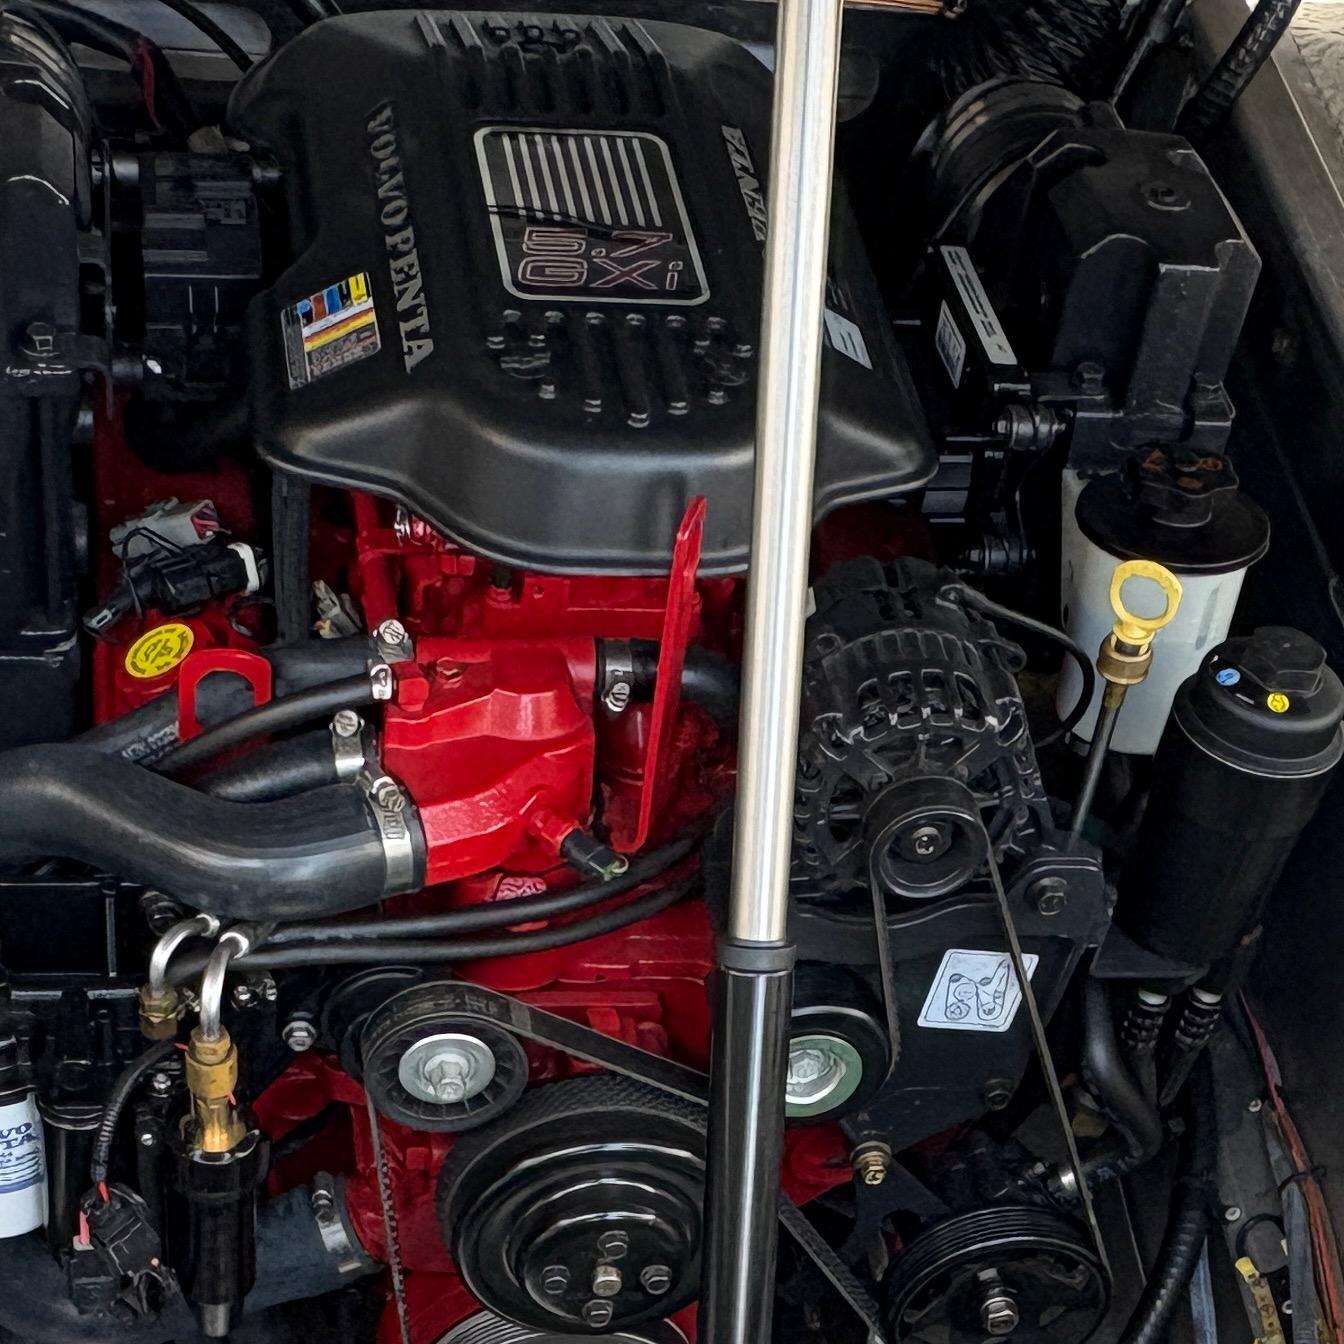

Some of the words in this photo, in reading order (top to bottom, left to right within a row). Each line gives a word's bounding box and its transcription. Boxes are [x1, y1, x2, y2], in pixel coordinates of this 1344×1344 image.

[365, 102, 409, 226] VOLVO
[517, 256, 684, 291] GXi
[522, 226, 674, 258] 5.7
[385, 225, 434, 375] PENTA
